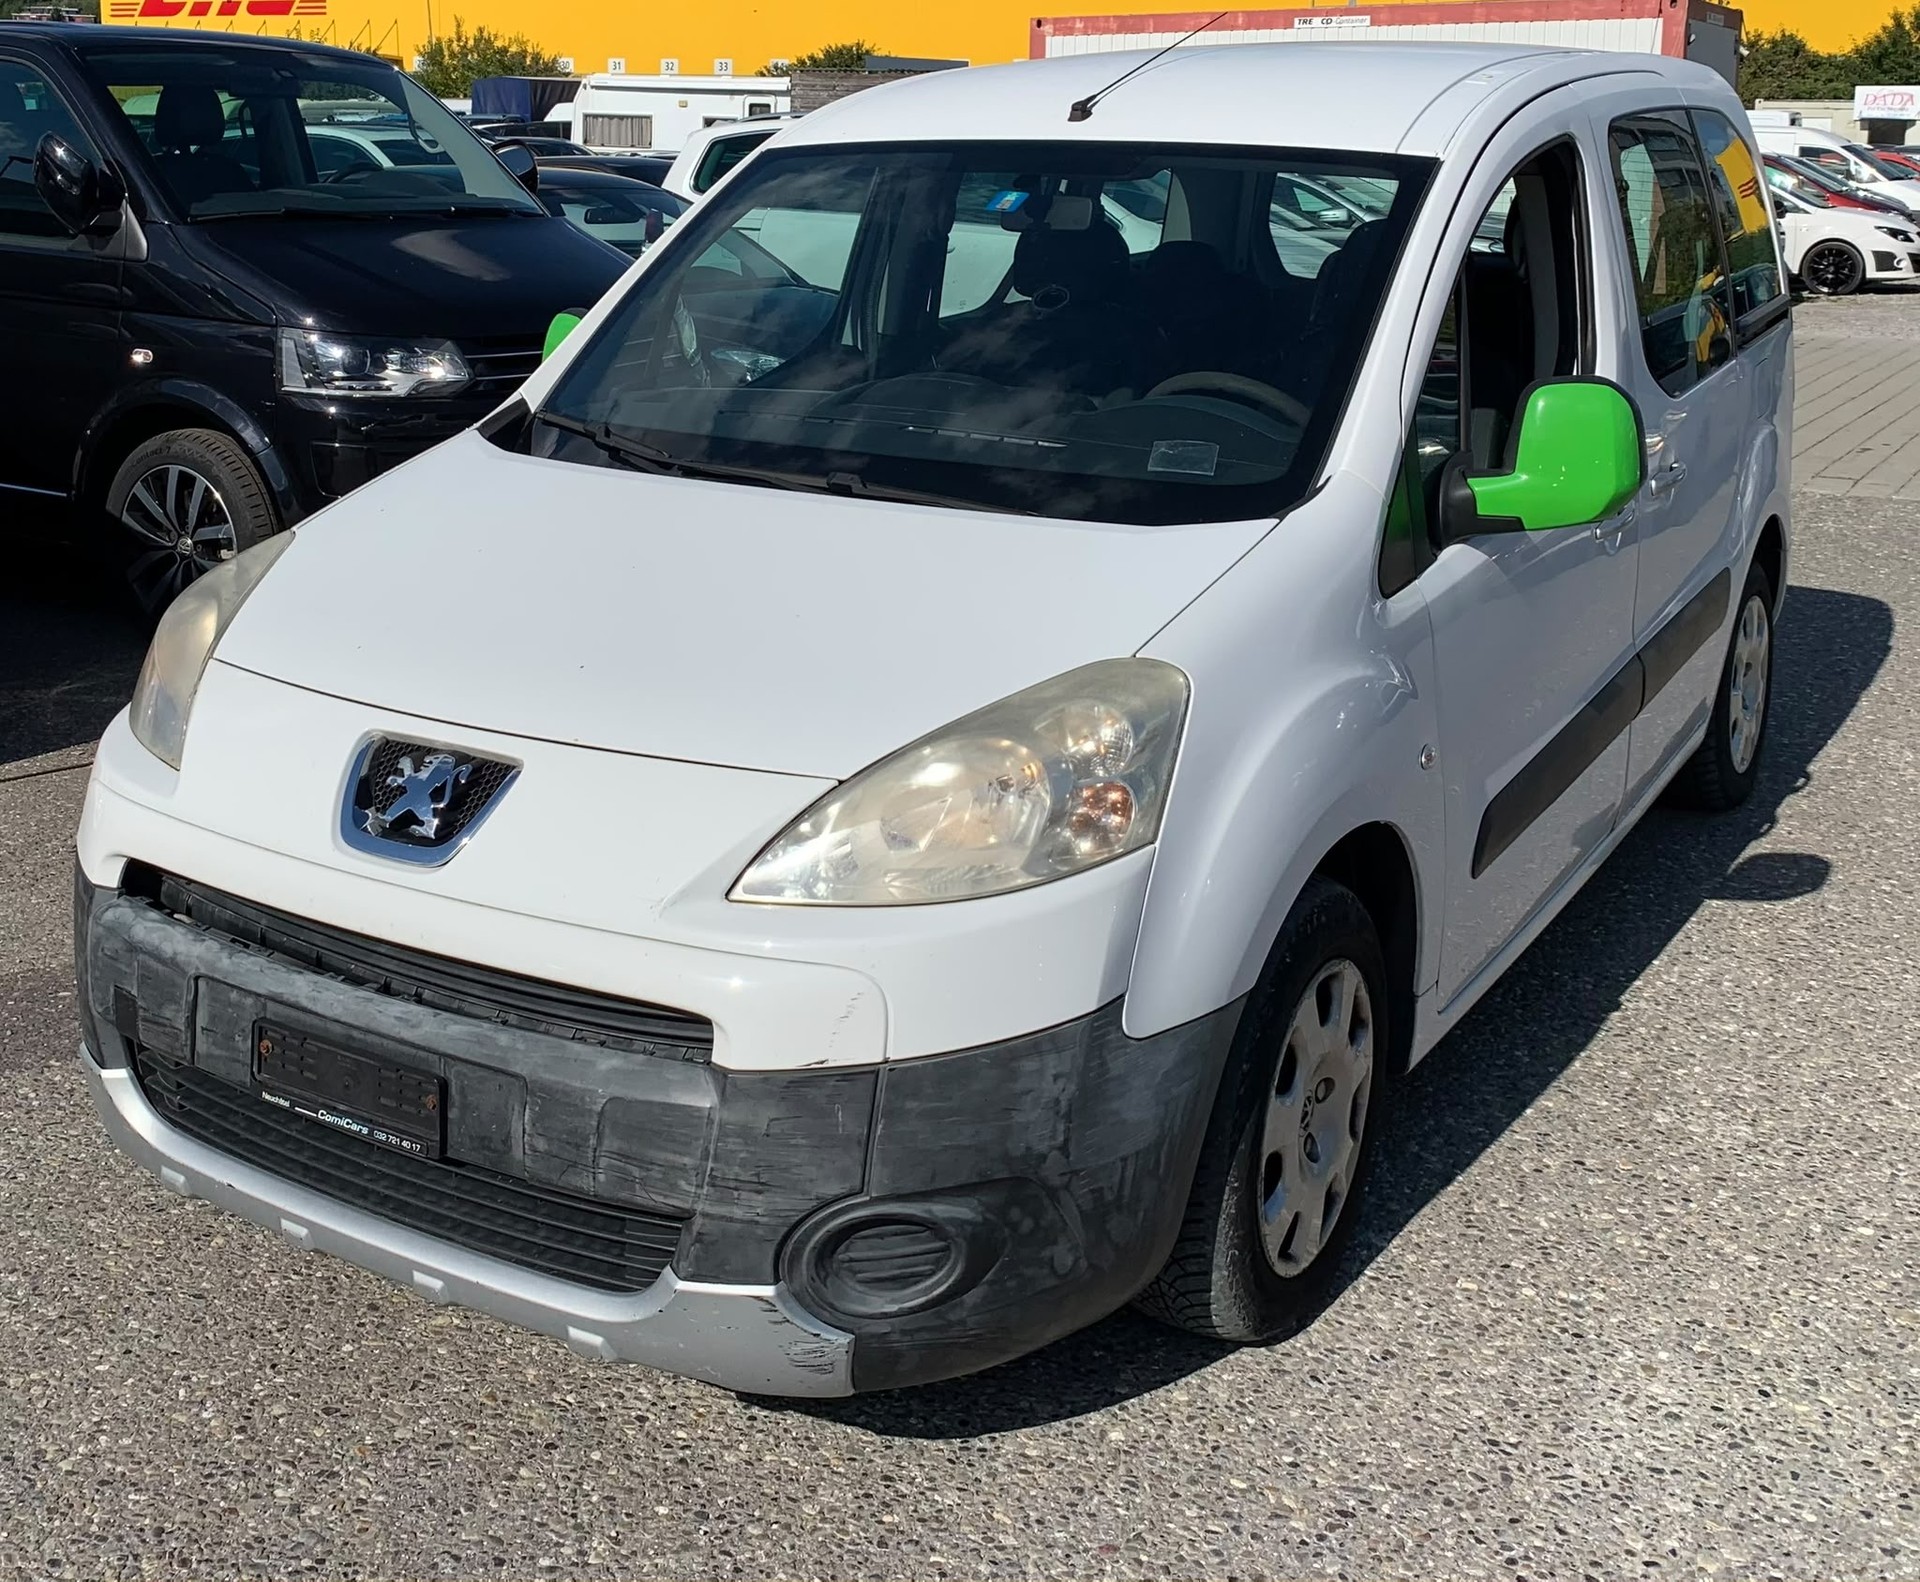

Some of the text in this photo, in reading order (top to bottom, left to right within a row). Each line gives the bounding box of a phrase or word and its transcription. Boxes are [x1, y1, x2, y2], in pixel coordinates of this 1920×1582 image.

[612, 61, 622, 71] 31
[664, 61, 675, 71] 32
[718, 61, 729, 72] 33
[317, 1109, 369, 1135] ComiCars
[373, 1130, 387, 1142] 032
[387, 1134, 400, 1146] 721
[401, 1140, 411, 1149] 40
[411, 1143, 421, 1153] 17
